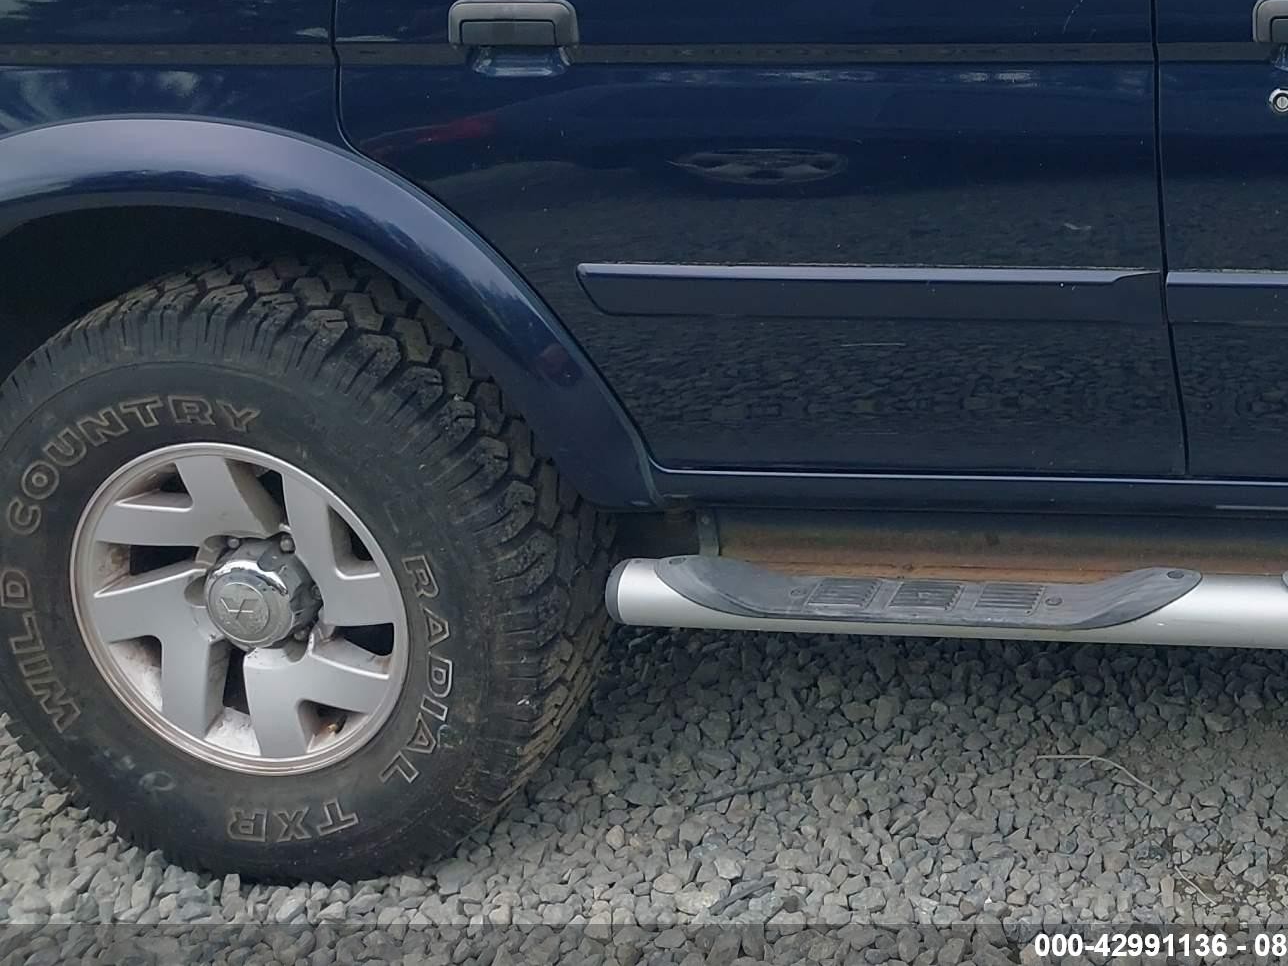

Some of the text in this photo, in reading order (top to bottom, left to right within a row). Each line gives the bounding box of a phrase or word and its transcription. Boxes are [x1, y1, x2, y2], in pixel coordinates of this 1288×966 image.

[1, 393, 262, 734] WILD COUNTRY
[379, 554, 453, 784] RADIAL
[227, 797, 360, 843] TXR
